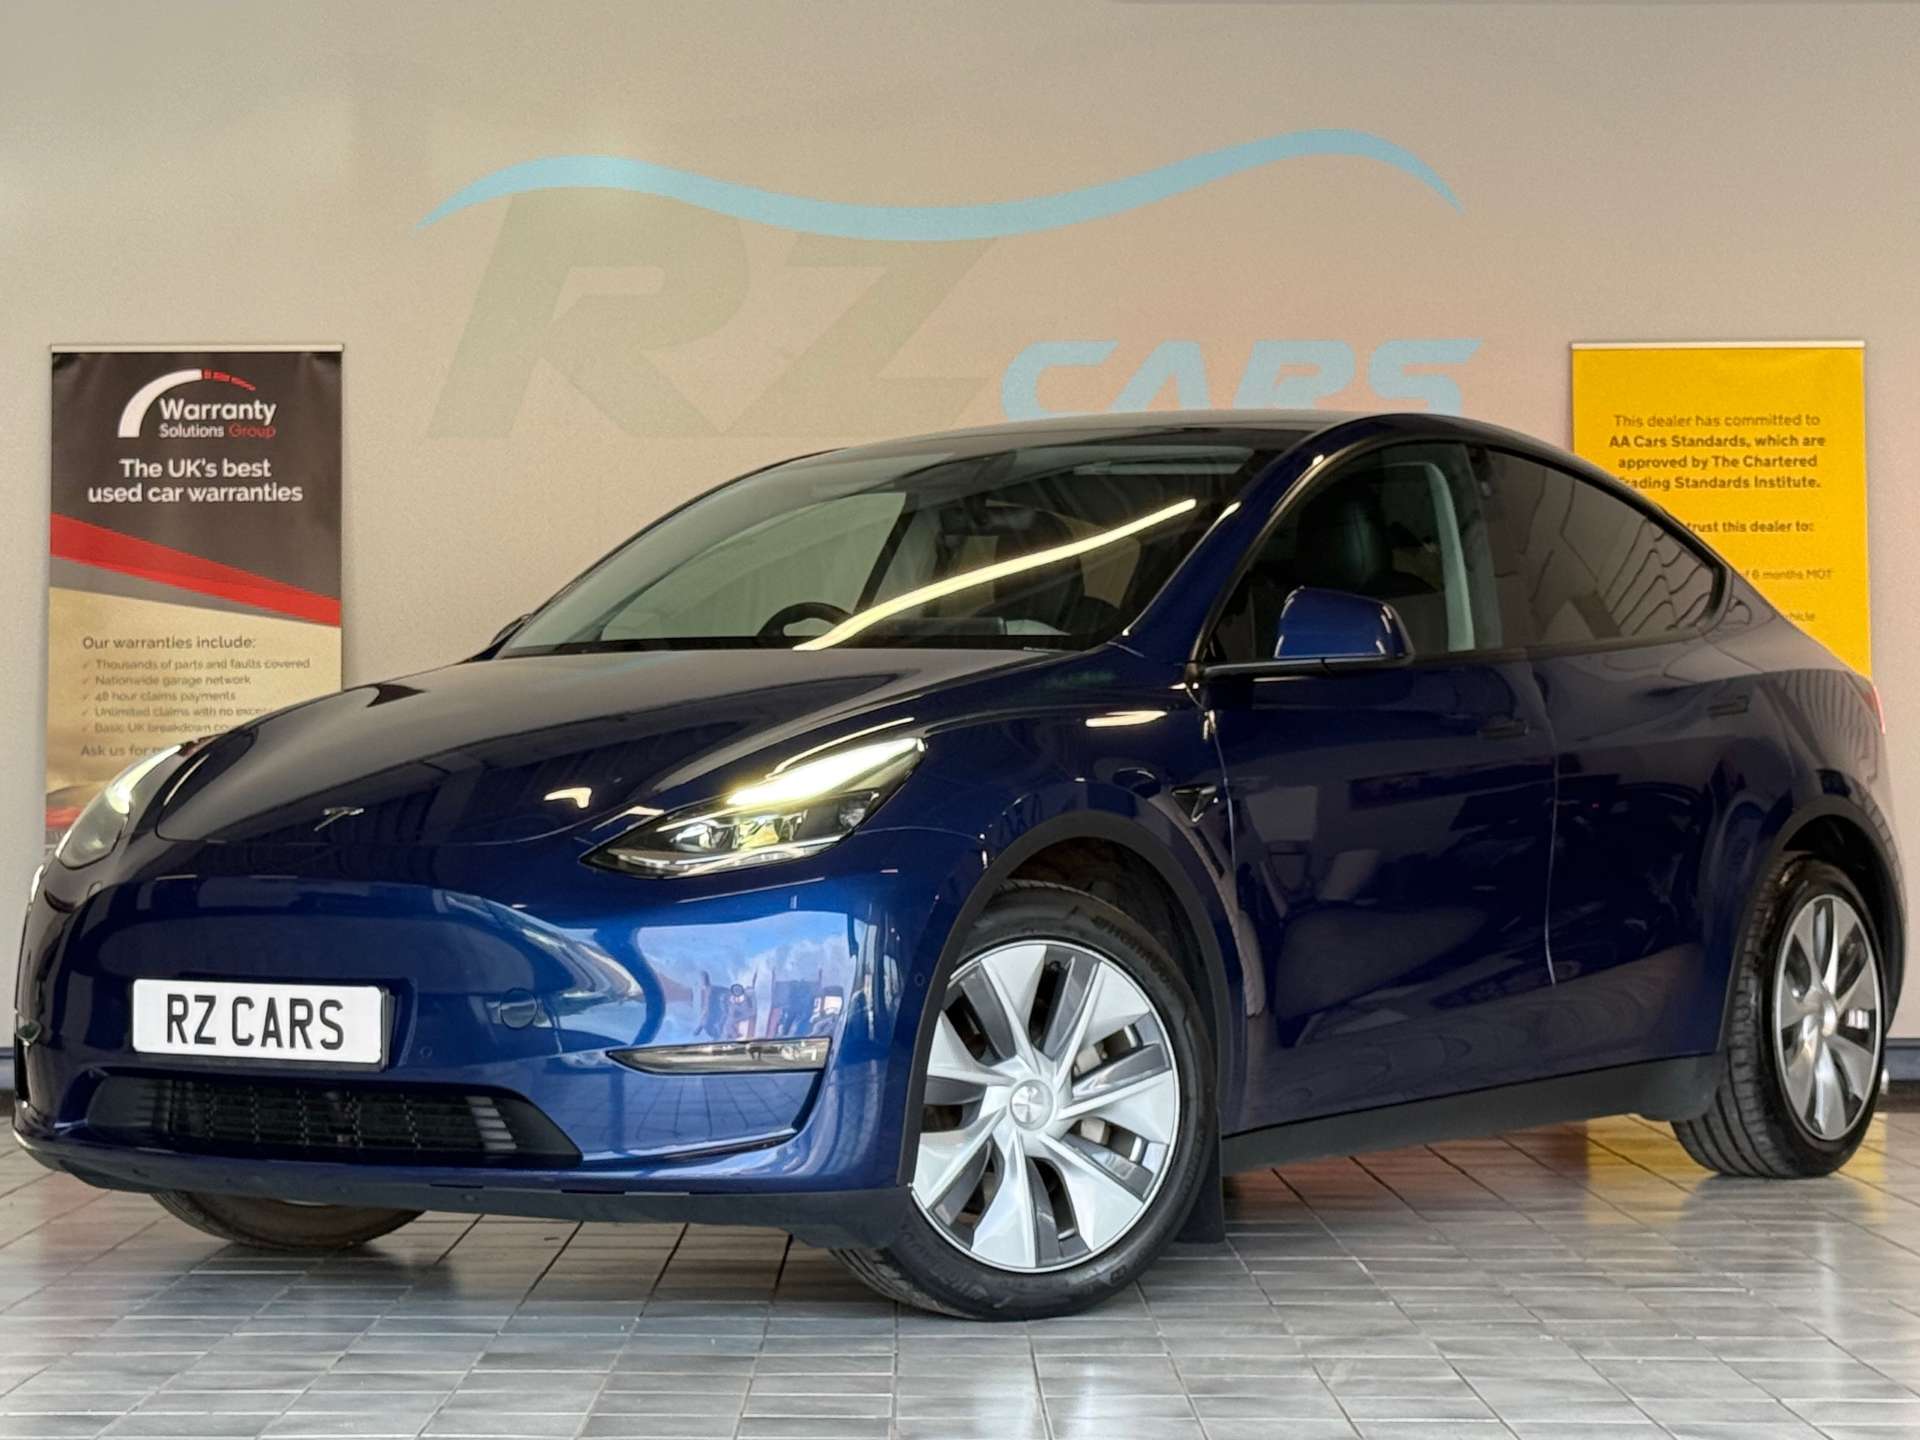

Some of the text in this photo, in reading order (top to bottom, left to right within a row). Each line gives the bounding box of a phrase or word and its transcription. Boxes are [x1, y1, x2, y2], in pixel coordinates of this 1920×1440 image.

[428, 186, 1002, 438] RZ
[1001, 338, 1484, 420] CARS
[160, 398, 277, 425] Warranty
[1614, 413, 1820, 427] This dealer has committed to
[159, 423, 276, 439] Solutions Group
[1609, 435, 1825, 449] AA Cars Standards, which are
[119, 459, 271, 478] The UK's best
[1618, 455, 1817, 471] approved by The Chartered
[1674, 477, 1750, 489] Standards
[1754, 476, 1821, 489] Institute.
[88, 482, 303, 502] used car warranties
[1722, 521, 1747, 533] this
[1750, 520, 1792, 532] dealer
[1795, 520, 1814, 532] to:
[83, 635, 256, 649] Our warranties include:
[96, 658, 311, 672] Thousands of parts and faults covered
[95, 674, 252, 689] Nationwide garage network
[95, 691, 236, 704] 48 hour claims payments
[94, 706, 150, 717] Unlimited
[152, 706, 190, 717] claims
[193, 706, 217, 716] with
[219, 707, 233, 717] no
[94, 722, 123, 733] Basic
[127, 722, 145, 733] UK
[148, 722, 211, 733] breakdown
[81, 744, 106, 756] Ask
[109, 746, 126, 756] us
[129, 744, 149, 756] for
[167, 993, 344, 1050] RZ CARS
